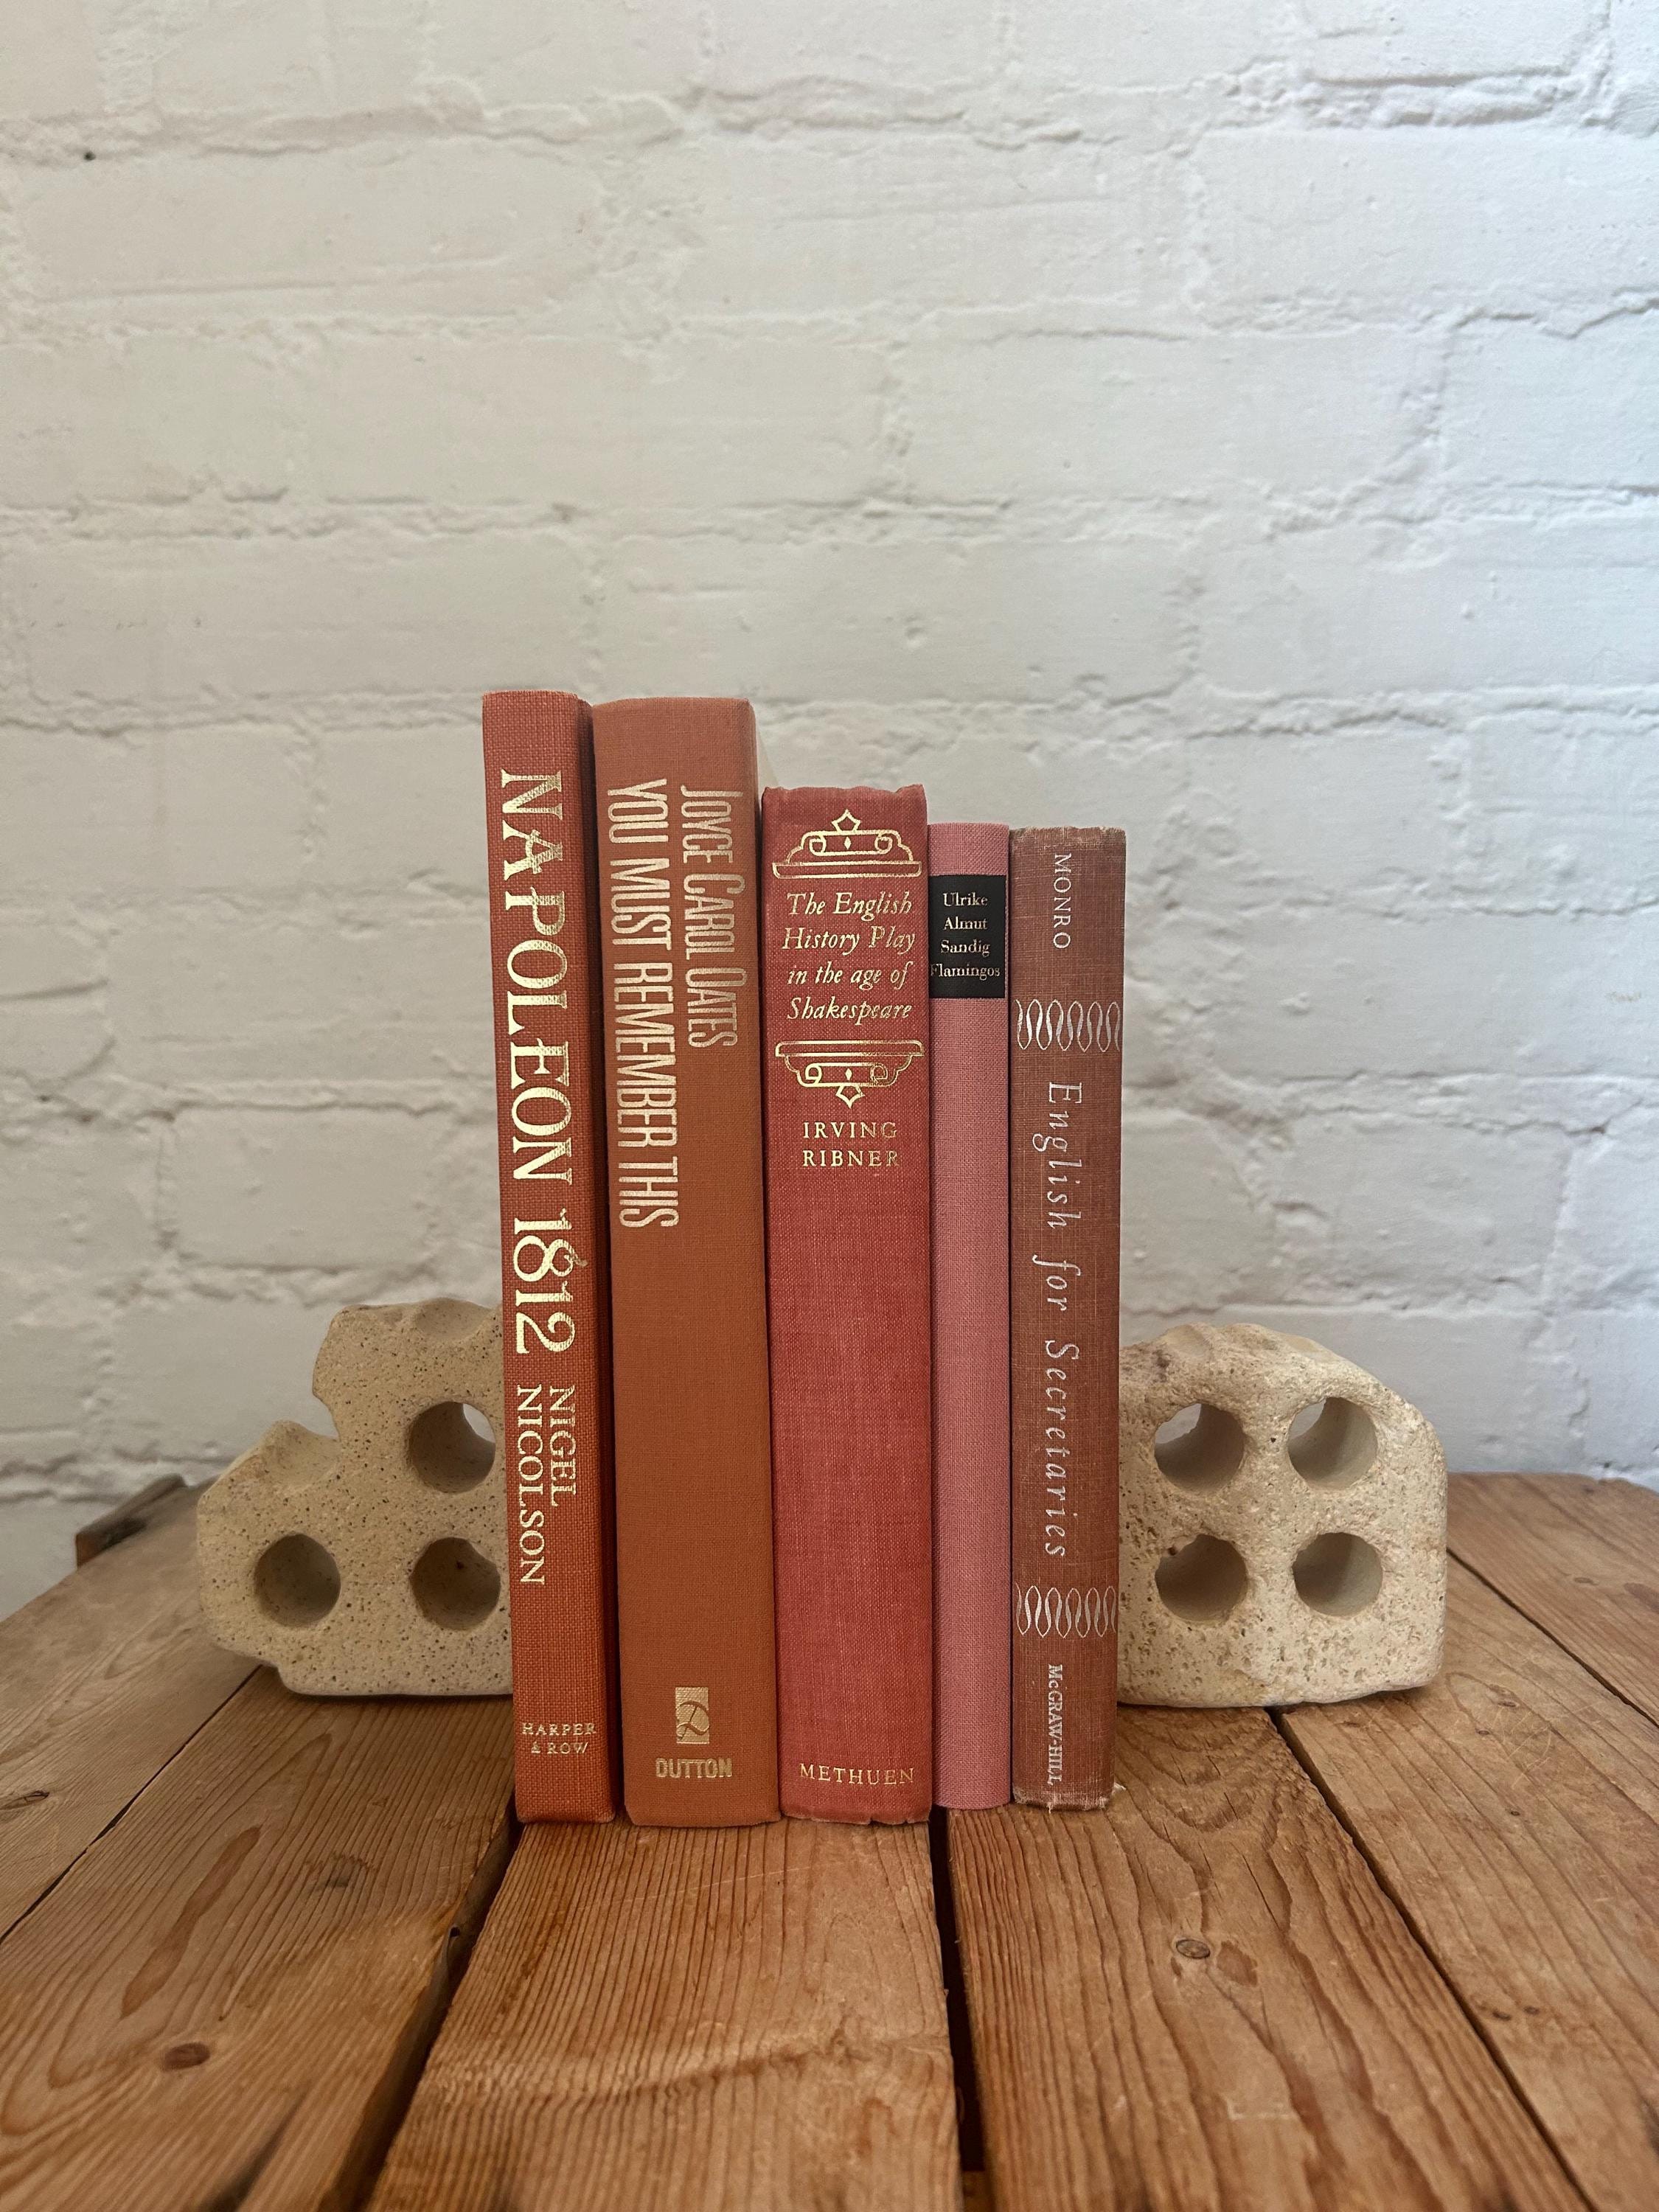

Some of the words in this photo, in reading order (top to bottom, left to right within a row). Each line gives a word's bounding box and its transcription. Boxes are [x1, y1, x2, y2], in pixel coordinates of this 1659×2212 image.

[607, 778, 669, 844] YOU
[680, 784, 744, 864] JOYCE
[610, 857, 672, 950] MUST
[683, 872, 746, 961] CAROL
[787, 892, 827, 915] The
[833, 890, 914, 921] English
[943, 891, 988, 906] Ulrike
[944, 916, 988, 930] Almut
[1053, 852, 1071, 949] MONRO
[782, 927, 860, 956] History
[869, 925, 916, 954] Play
[931, 962, 1001, 981] Flamingos
[940, 939, 990, 957] Sandig
[501, 769, 572, 1185] NAPOLEON
[787, 964, 808, 984] in
[815, 961, 843, 984] the
[850, 967, 882, 990] age
[890, 960, 913, 990] of
[685, 966, 747, 1048] OATES
[787, 995, 913, 1026] Shakespeare
[613, 961, 678, 1148] REMEMBER
[802, 1150, 899, 1167] RIBNER
[803, 1121, 897, 1138] IRVING
[1032, 1081, 1082, 1229] English
[618, 1155, 680, 1229] THIS
[512, 1208, 587, 1355] 1812
[1032, 1253, 1081, 1312] for
[549, 1384, 577, 1506] NIGEL
[1044, 1338, 1080, 1557] Secretaries
[516, 1383, 546, 1585] NICOLSON
[522, 1722, 596, 1735] HARPER
[547, 1742, 588, 1753] ROW
[1047, 1664, 1062, 1786] McGRAW-HILL
[655, 1758, 732, 1778] DUTTON
[800, 1763, 914, 1785] METHUEN
